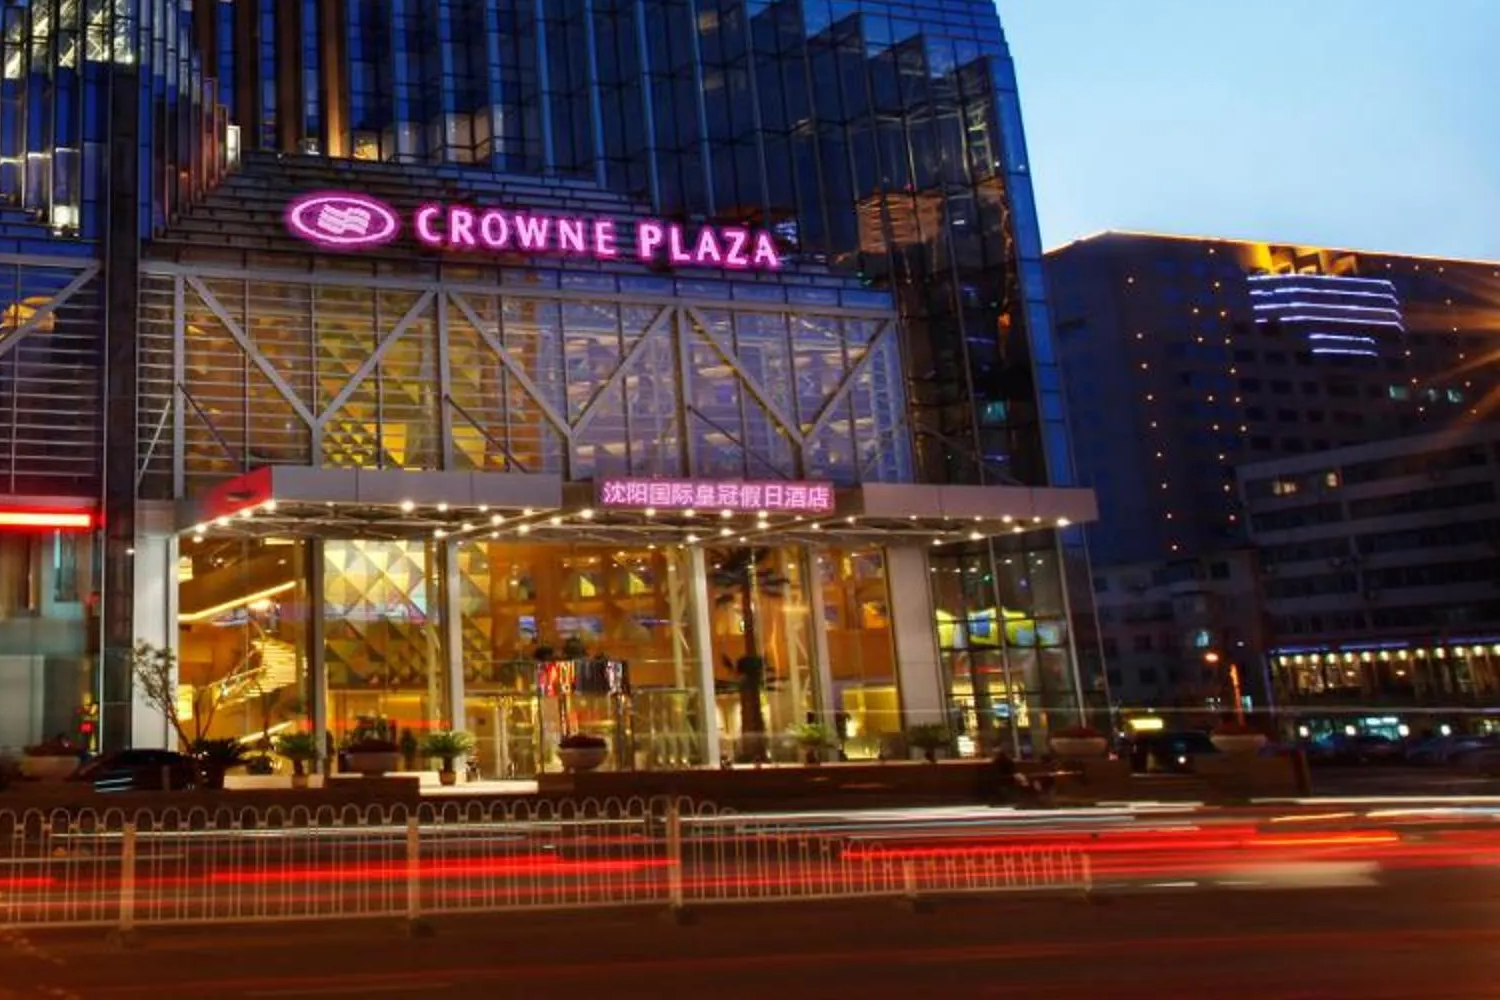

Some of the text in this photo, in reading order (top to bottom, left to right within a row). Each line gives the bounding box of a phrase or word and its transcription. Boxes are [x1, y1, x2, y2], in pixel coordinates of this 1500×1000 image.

[417, 206, 779, 268] CROWNE PLAZA
[603, 481, 831, 510] 沈阳国际皇冠假日酒店
